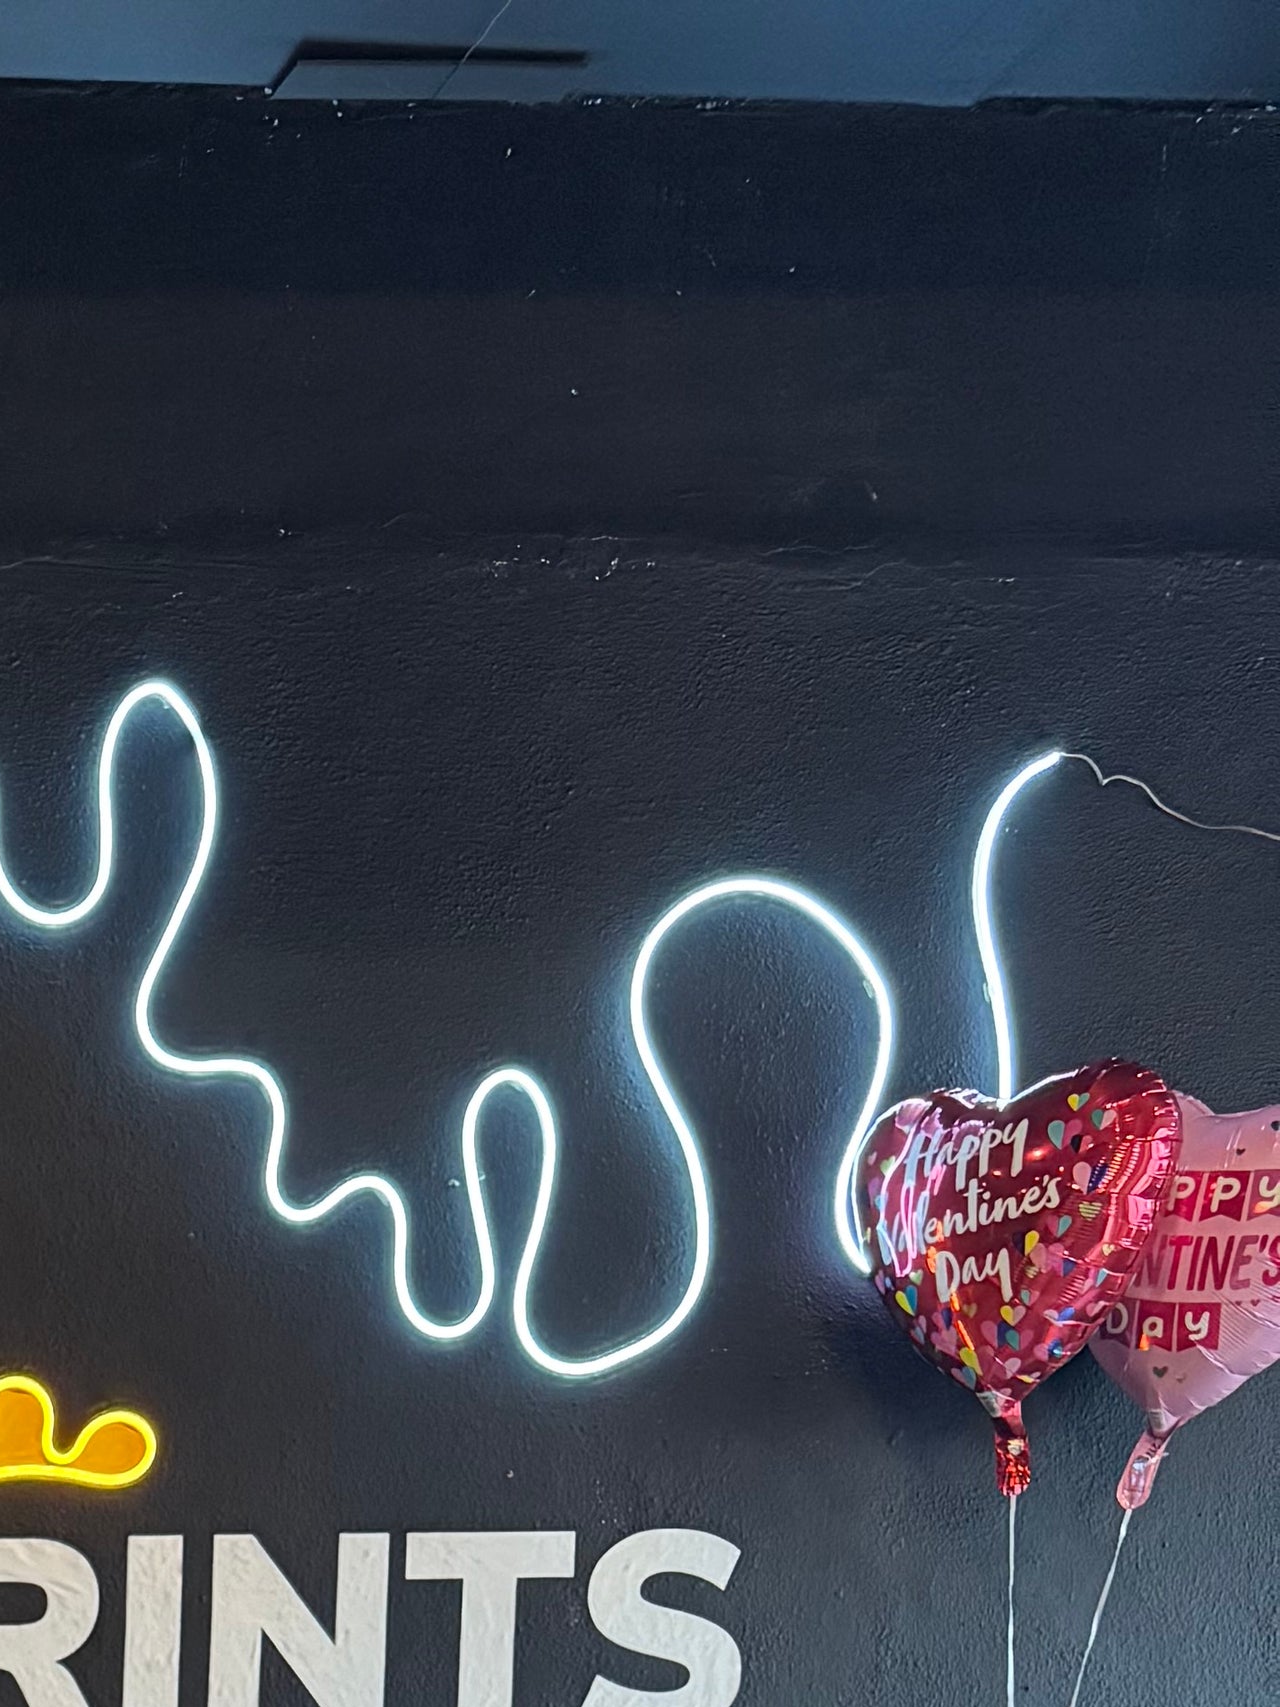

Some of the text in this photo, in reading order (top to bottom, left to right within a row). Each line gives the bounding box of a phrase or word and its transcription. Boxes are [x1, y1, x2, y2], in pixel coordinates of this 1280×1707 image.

[904, 1118, 1029, 1192] Happy
[876, 1175, 1062, 1266] Valentine's
[1168, 1176, 1280, 1213] ppy
[935, 1248, 1013, 1303] Day
[1135, 1235, 1280, 1292] NTINE'S
[1106, 1303, 1210, 1341] Day
